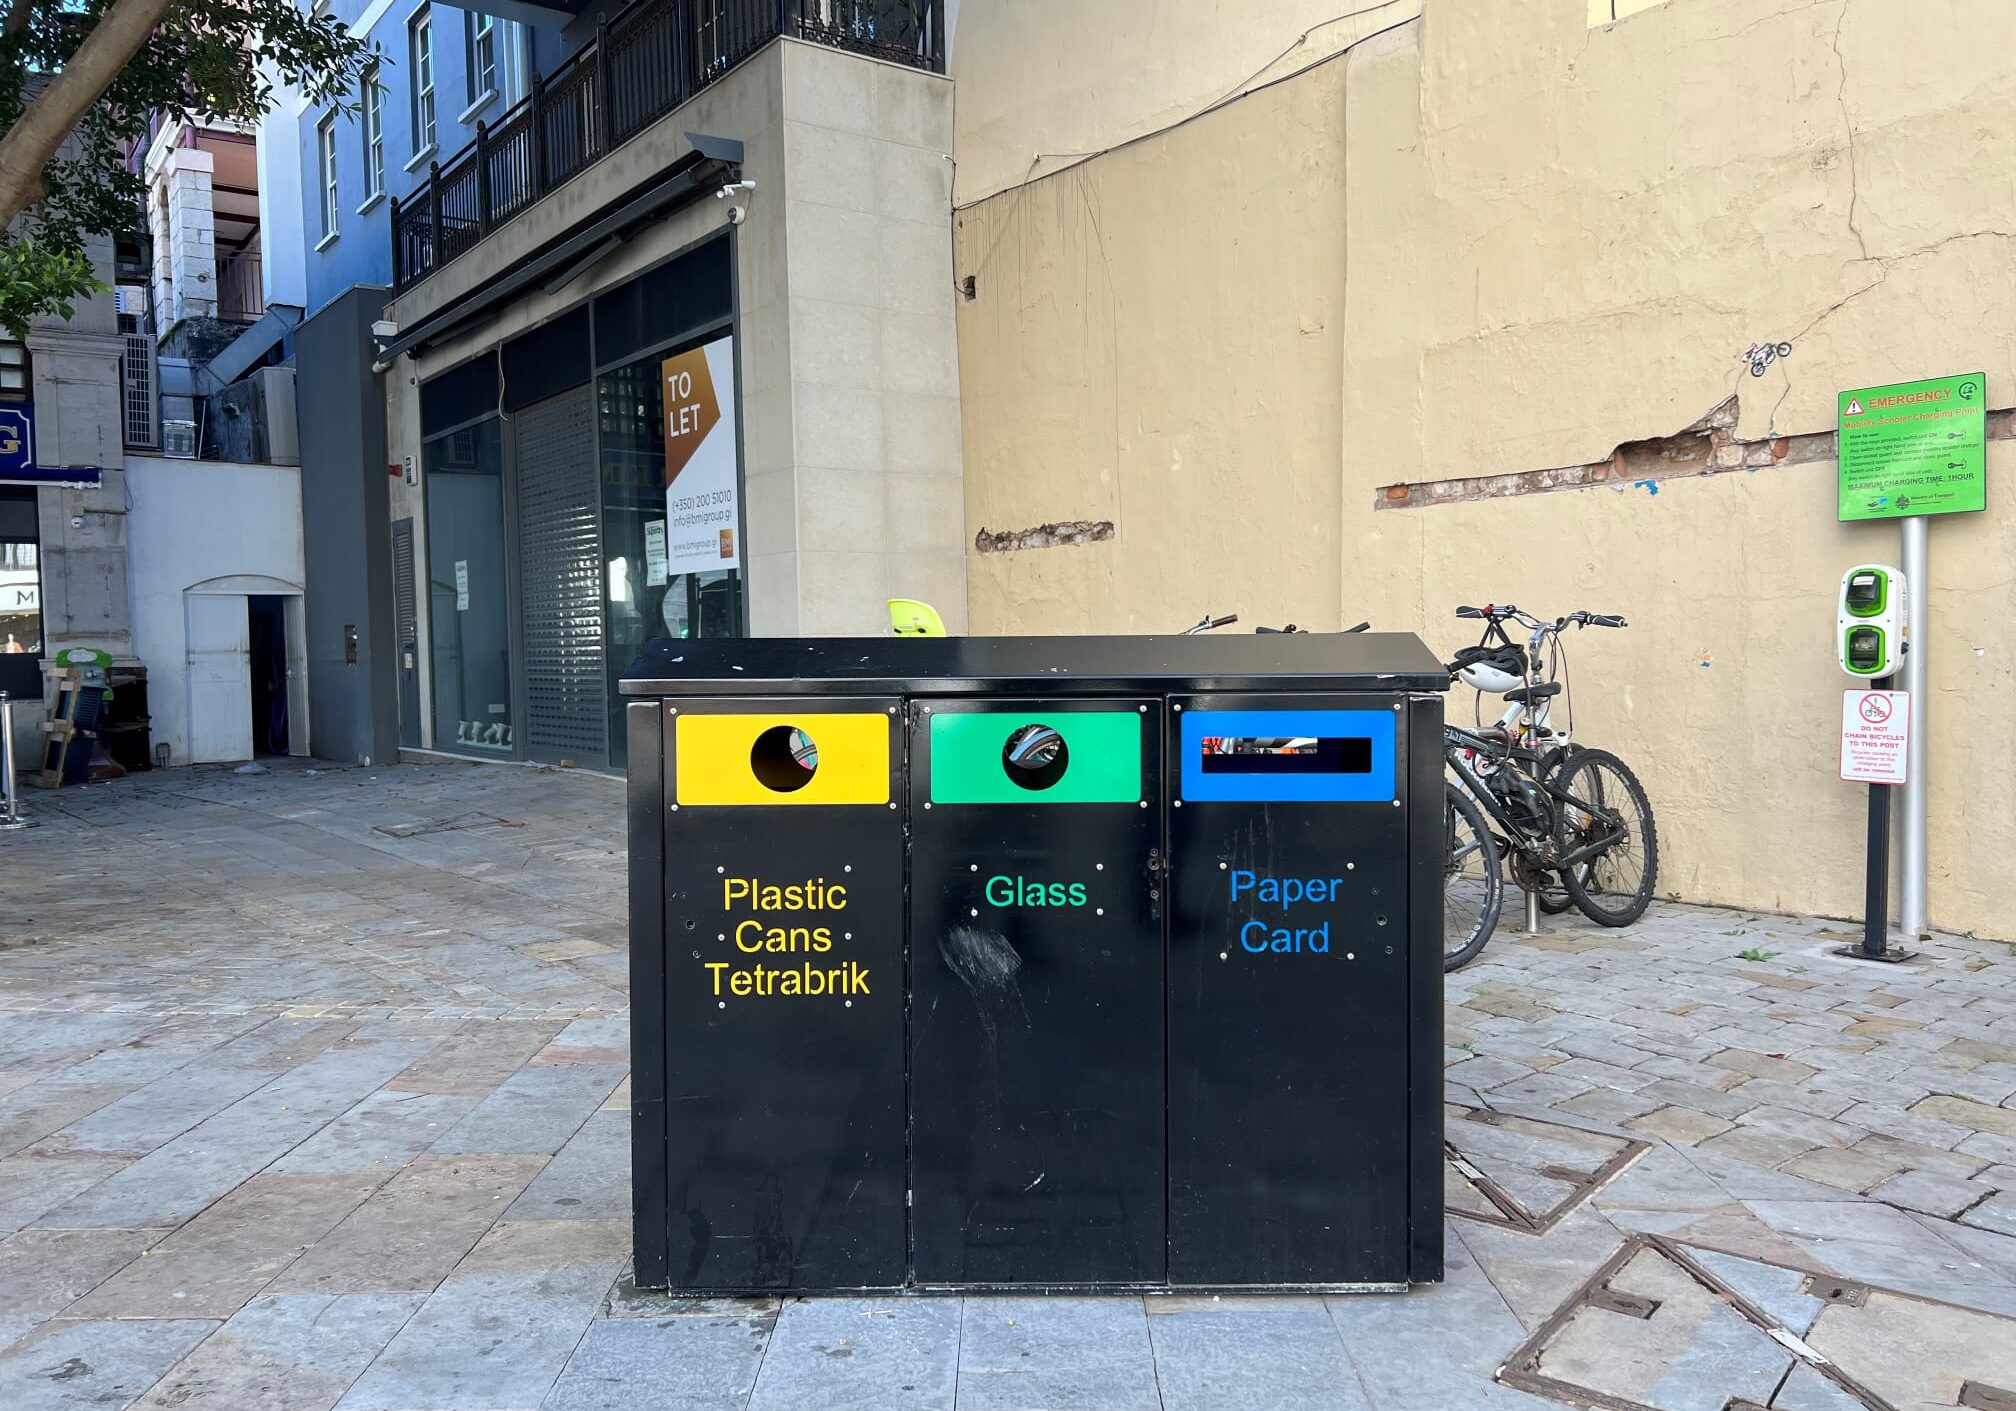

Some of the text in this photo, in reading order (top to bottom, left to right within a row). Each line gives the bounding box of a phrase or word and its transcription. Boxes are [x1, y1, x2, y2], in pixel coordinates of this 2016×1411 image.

[668, 370, 691, 402] TO
[1868, 389, 1952, 409] EMERGENCY
[669, 403, 701, 438] LET
[1844, 407, 1979, 429] Mobility Scooter Charging Point
[1848, 481, 1882, 490] MAXIMUM
[1884, 477, 1923, 487] CHARGING
[672, 489, 732, 513] (+350) 200 51010
[1869, 733, 1905, 741] BICYCLES
[725, 878, 846, 911] Plastic
[986, 876, 1087, 907] Glass
[1231, 870, 1343, 911] Paper
[736, 920, 831, 953] Cans
[1240, 919, 1329, 953] Card
[706, 962, 870, 996] Tetrabrik
